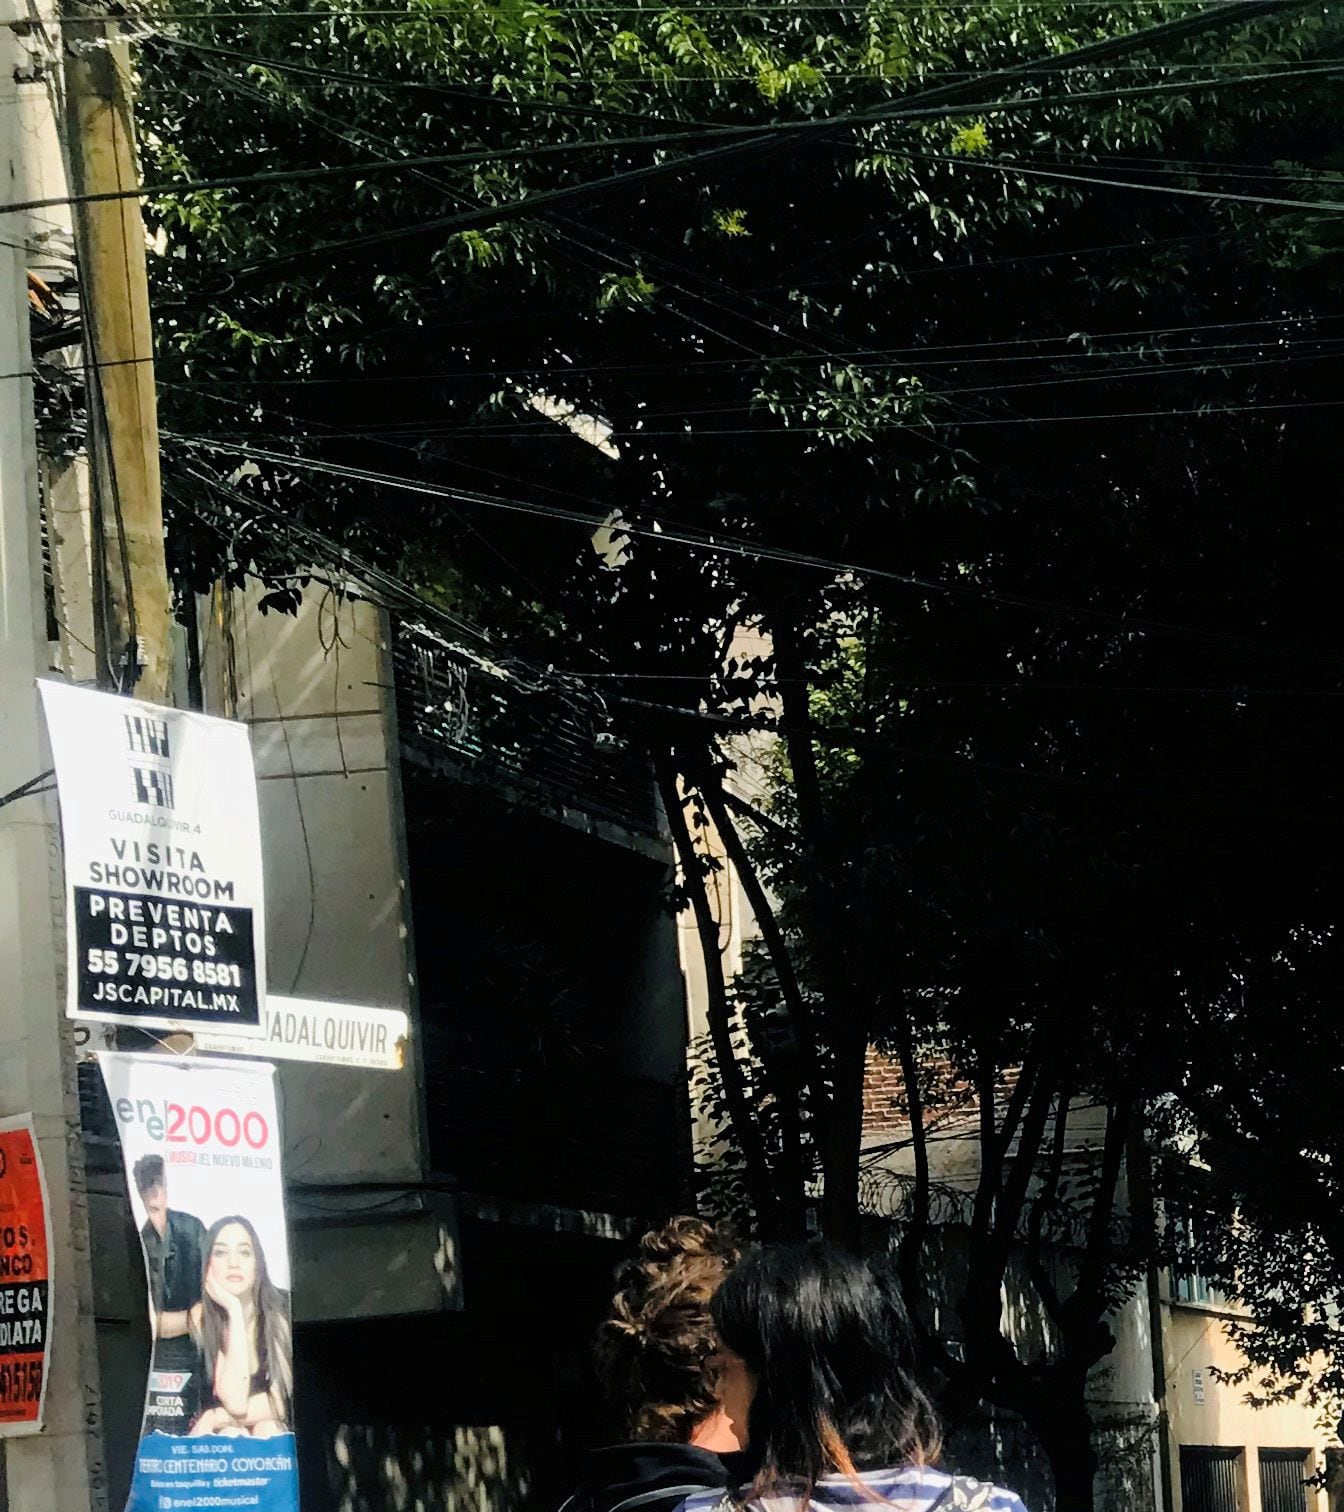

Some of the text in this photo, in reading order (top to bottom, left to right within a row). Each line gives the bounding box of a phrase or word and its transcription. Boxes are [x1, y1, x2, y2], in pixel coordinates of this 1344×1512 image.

[110, 838, 206, 873] VISITA
[89, 861, 235, 901] SHOWROOM
[89, 894, 234, 934] PREVENTA
[110, 922, 217, 957] DEPTOS
[87, 948, 241, 988] 55 7956 8581
[92, 981, 241, 1013] JSCAPITAL.MX
[265, 1010, 388, 1054] ADALQUIVIR
[163, 1457, 228, 1474] CENTENARIO
